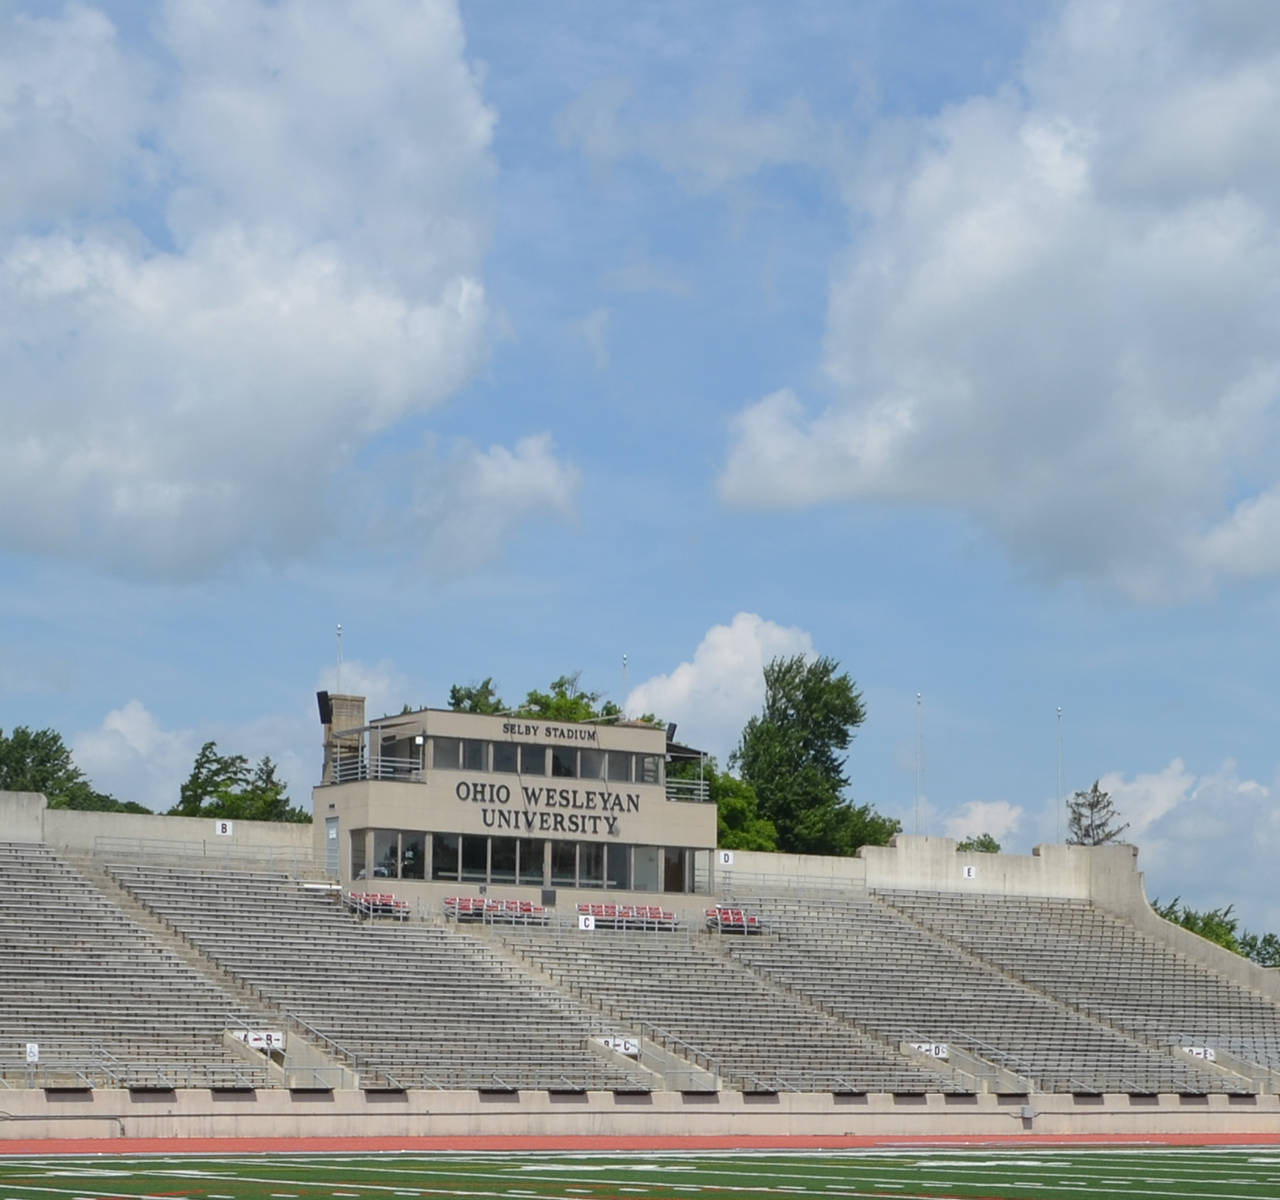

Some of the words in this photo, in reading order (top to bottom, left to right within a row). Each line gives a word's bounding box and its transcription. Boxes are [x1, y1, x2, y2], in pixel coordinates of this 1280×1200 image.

[502, 723, 539, 737] SELBY
[544, 727, 596, 742] STADIUM
[456, 781, 511, 804] OHIO
[522, 786, 640, 813] WESLEYAN
[221, 823, 228, 834] B
[482, 808, 618, 836] UNIVERSITY
[583, 916, 591, 929] C
